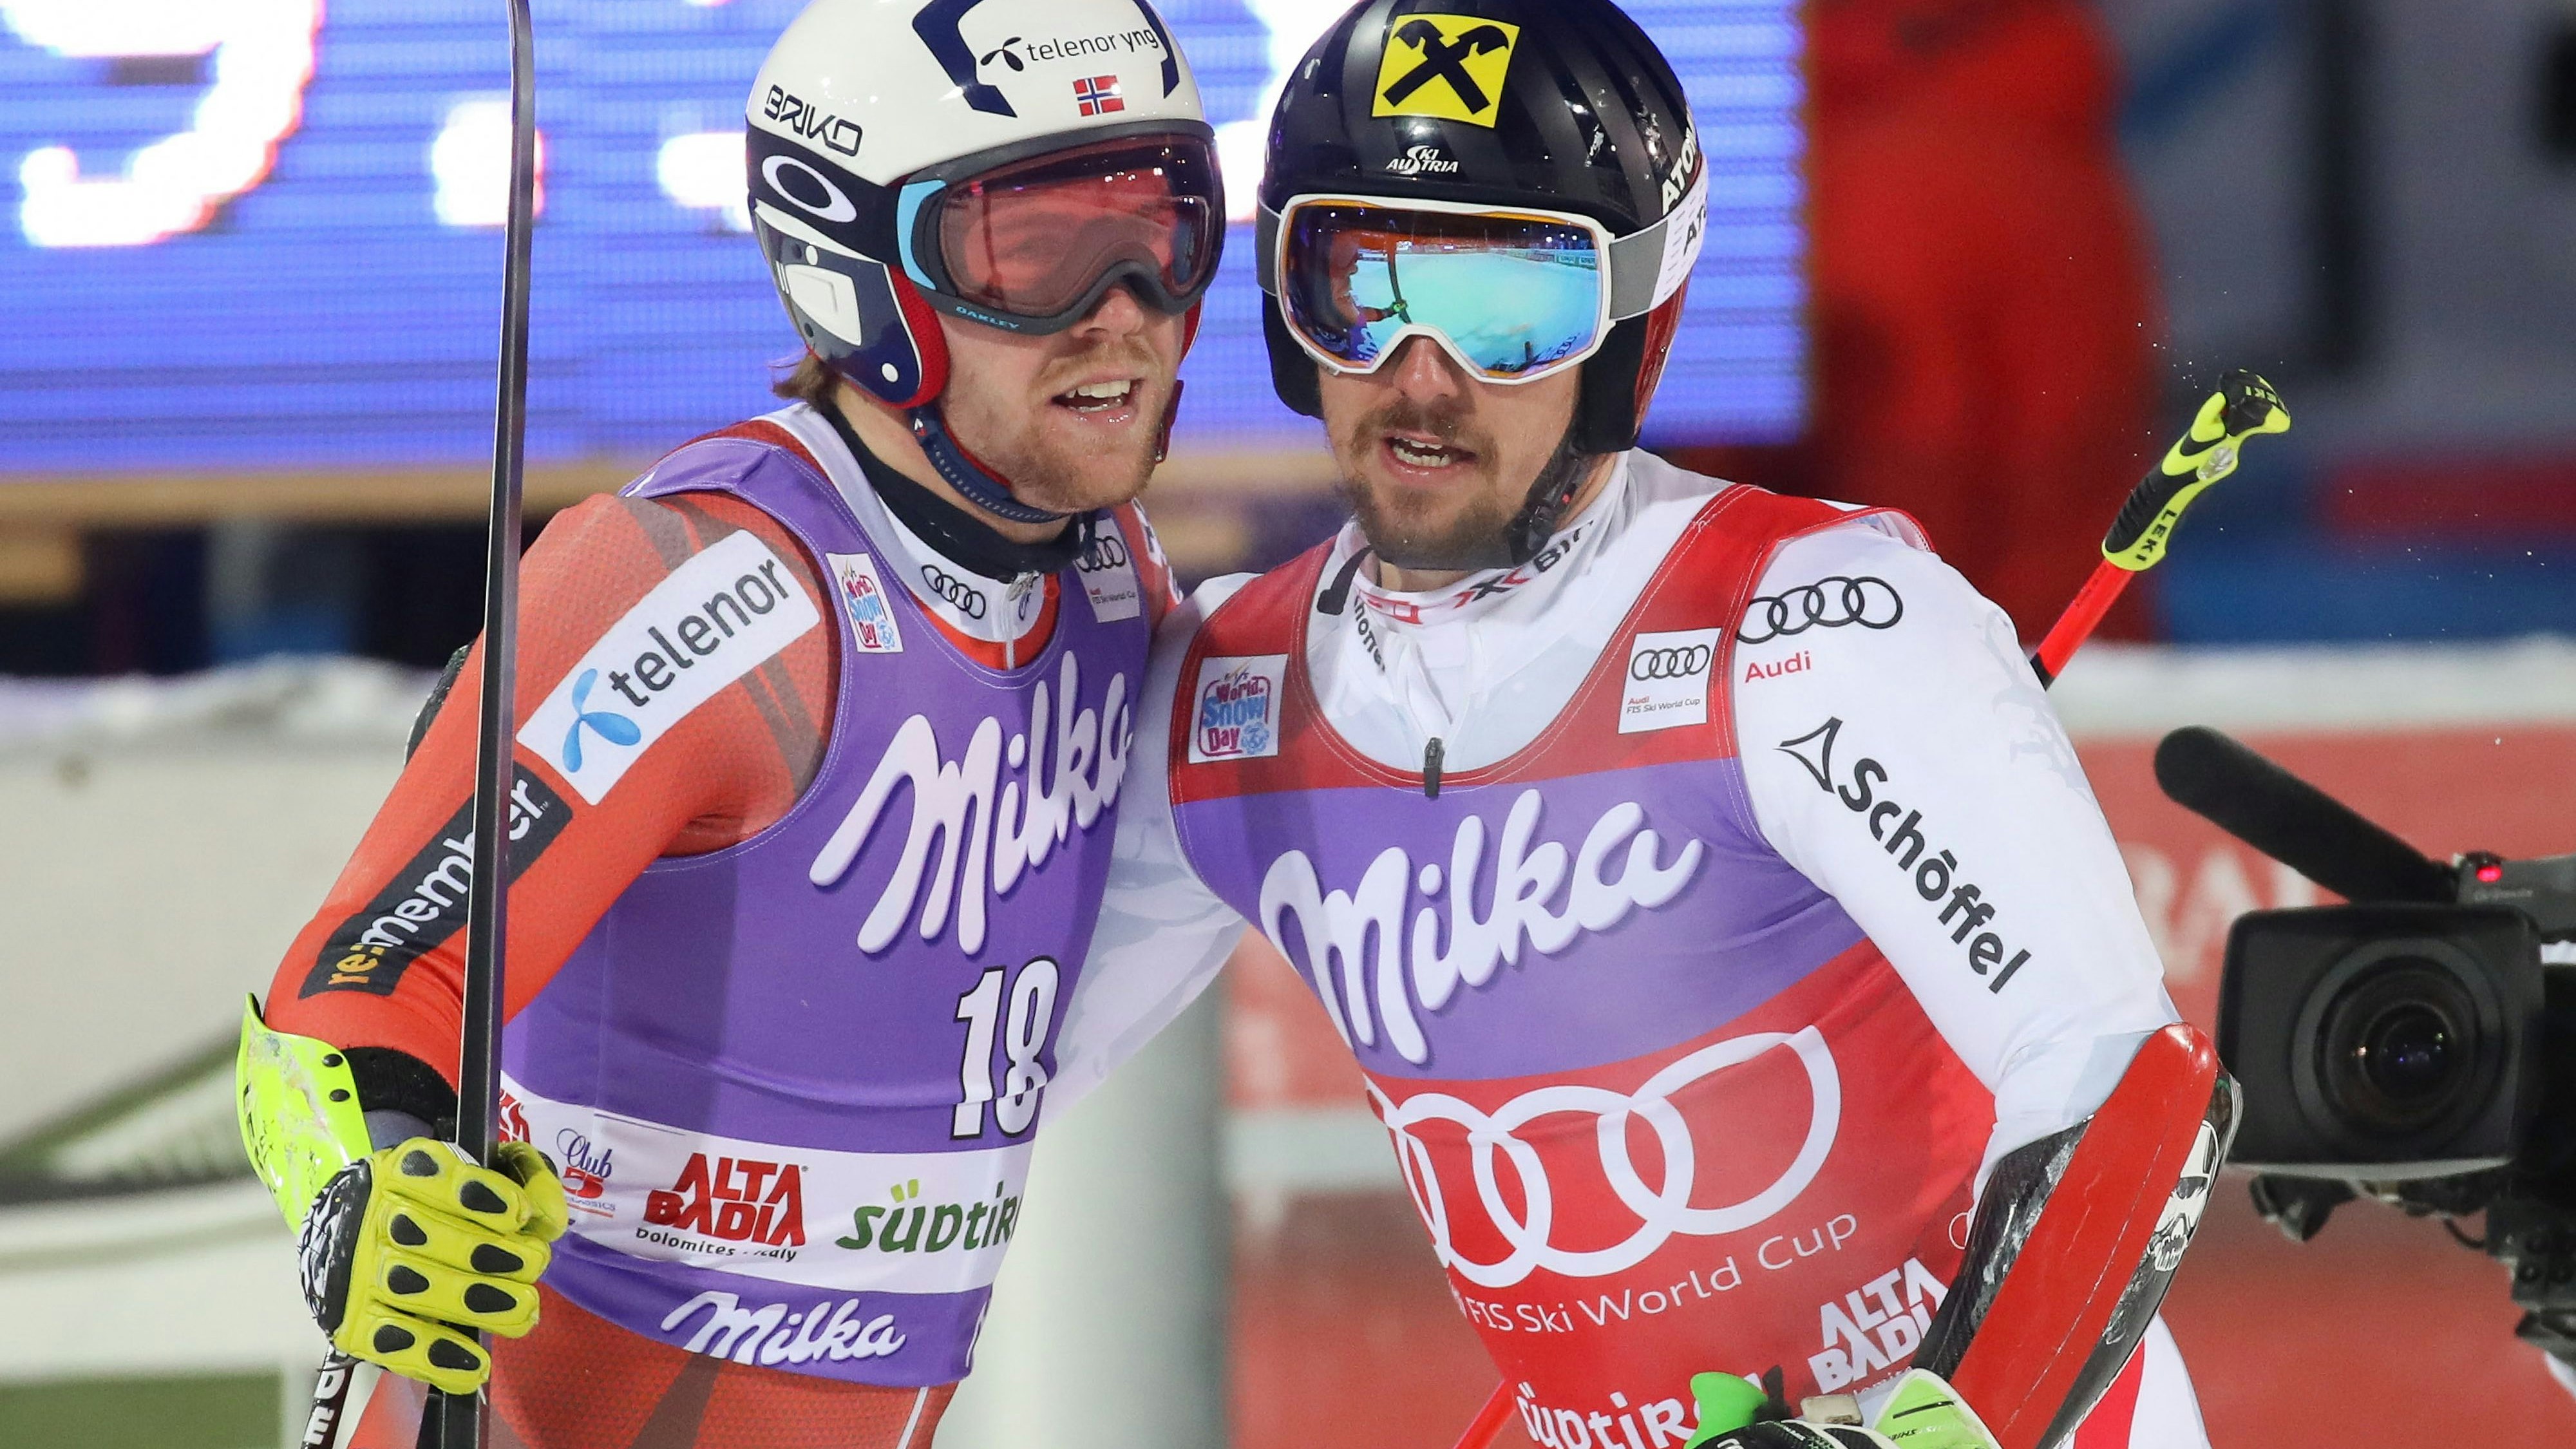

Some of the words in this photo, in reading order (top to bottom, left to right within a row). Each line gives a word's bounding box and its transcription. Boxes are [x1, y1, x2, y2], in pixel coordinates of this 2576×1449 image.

[1026, 34, 1117, 62] telenor
[1120, 28, 1159, 53] yng
[764, 84, 863, 157] BRIKO
[1385, 153, 1459, 175] AUSTRIA
[1406, 144, 1440, 166] SKI
[956, 305, 1020, 329] OAKLEY
[2135, 509, 2178, 562] LEKI
[609, 558, 790, 708] telenor
[1744, 650, 1812, 683] Audi
[1202, 694, 1267, 728] Snow
[1627, 696, 1650, 705] Audi
[1627, 705, 1642, 714] FIS
[1643, 704, 1656, 713] Ski
[1658, 700, 1683, 710] World
[1684, 698, 1701, 706] Cup
[1208, 727, 1241, 752] Day
[809, 650, 1134, 955] Milka
[1259, 788, 1704, 1064] Milka
[950, 953, 1061, 1141] 18
[556, 1128, 612, 1179] Club
[672, 1151, 803, 1204] ALTA
[643, 1189, 806, 1247] BADIA
[1465, 1296, 1514, 1332] FIS
[1515, 1303, 1575, 1334] Ski
[1577, 1255, 1743, 1323] World
[1757, 1212, 1858, 1271] Cup
[661, 1290, 907, 1366] Milka
[1820, 1256, 1949, 1349] ALTA
